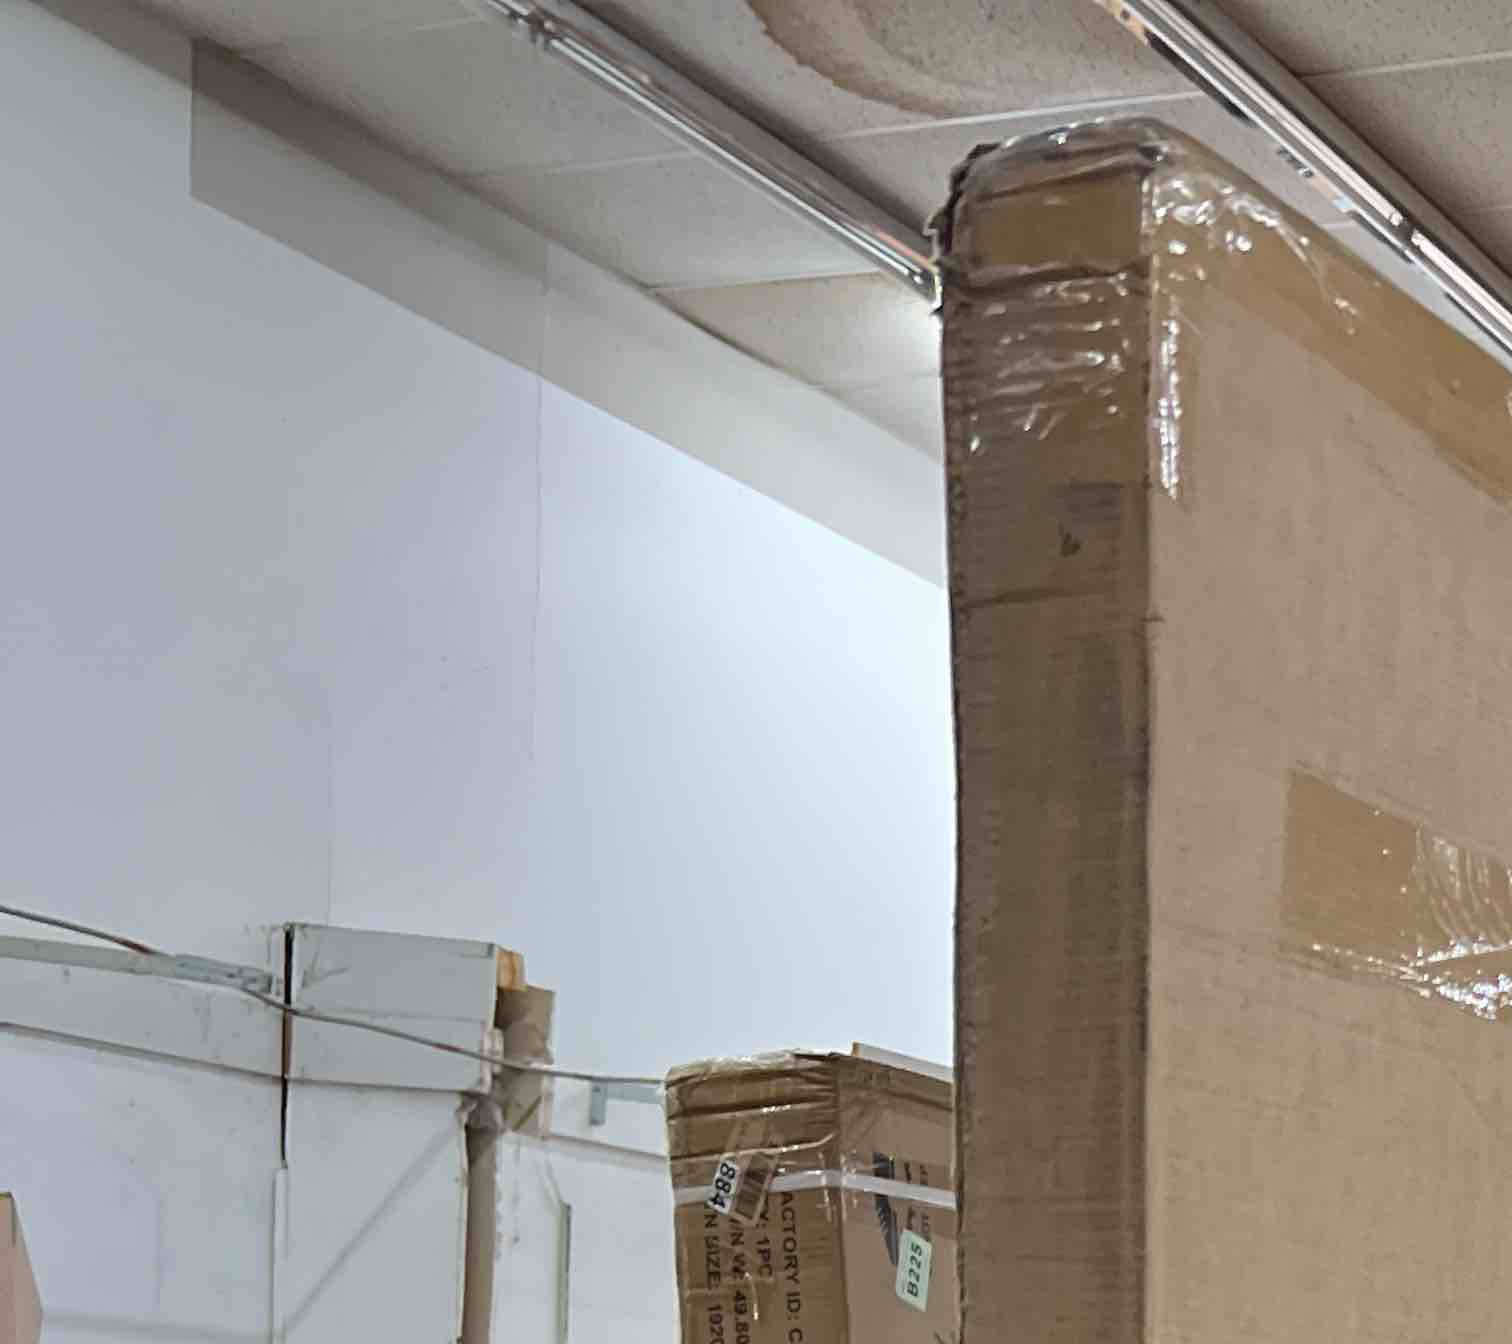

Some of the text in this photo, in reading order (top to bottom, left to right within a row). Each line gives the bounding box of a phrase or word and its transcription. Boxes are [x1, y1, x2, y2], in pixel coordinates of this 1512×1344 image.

[709, 1163, 736, 1210] 884
[781, 1190, 801, 1287] ACTORY
[905, 1241, 925, 1298] B225
